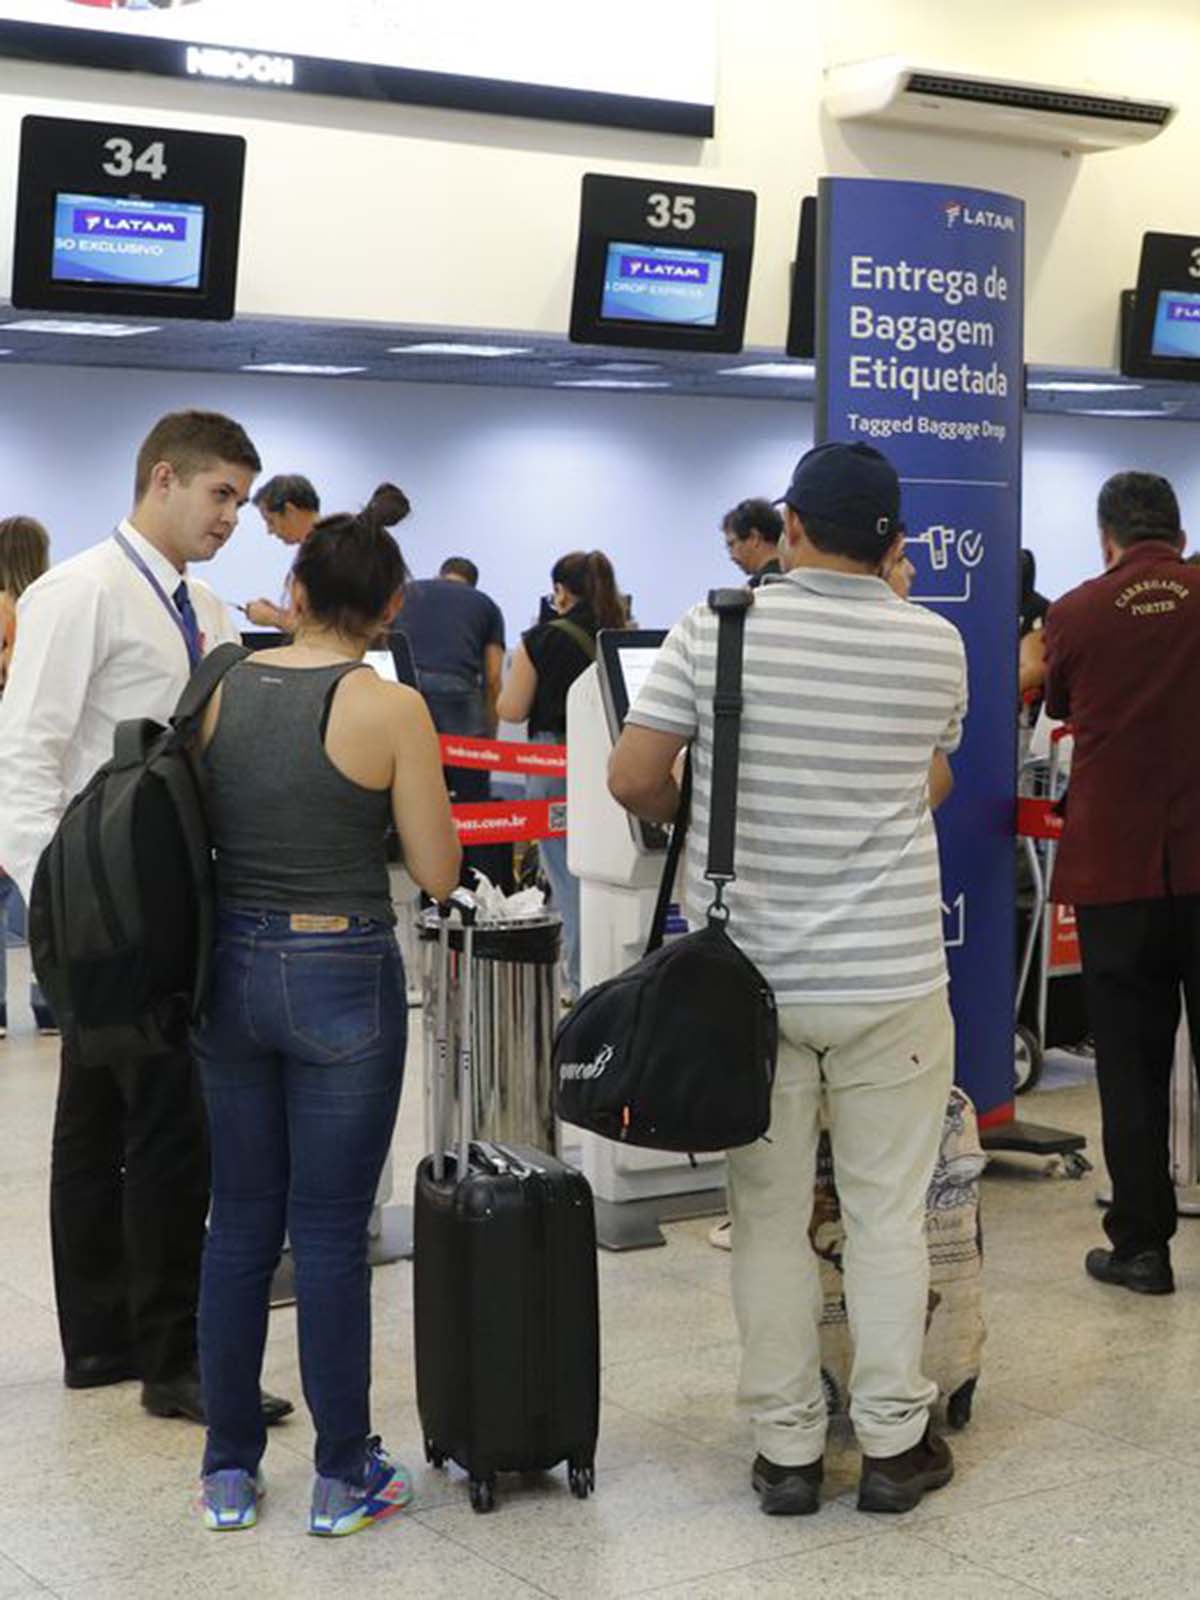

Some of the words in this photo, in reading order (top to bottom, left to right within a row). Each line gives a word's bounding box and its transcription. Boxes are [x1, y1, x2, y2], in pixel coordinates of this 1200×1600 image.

[102, 138, 167, 180] 34
[104, 217, 176, 233] LATAM
[646, 193, 696, 230] 35
[963, 208, 1015, 232] LATAM
[644, 263, 701, 278] LATAM
[850, 255, 978, 304] Entrega
[984, 265, 1008, 300] de
[850, 305, 994, 353] Bagagem
[850, 355, 1008, 401] Etiquetada
[848, 413, 914, 437] Tagged
[917, 416, 981, 440] Baggage
[982, 421, 1006, 442] Drop
[1131, 600, 1176, 616] PORTER
